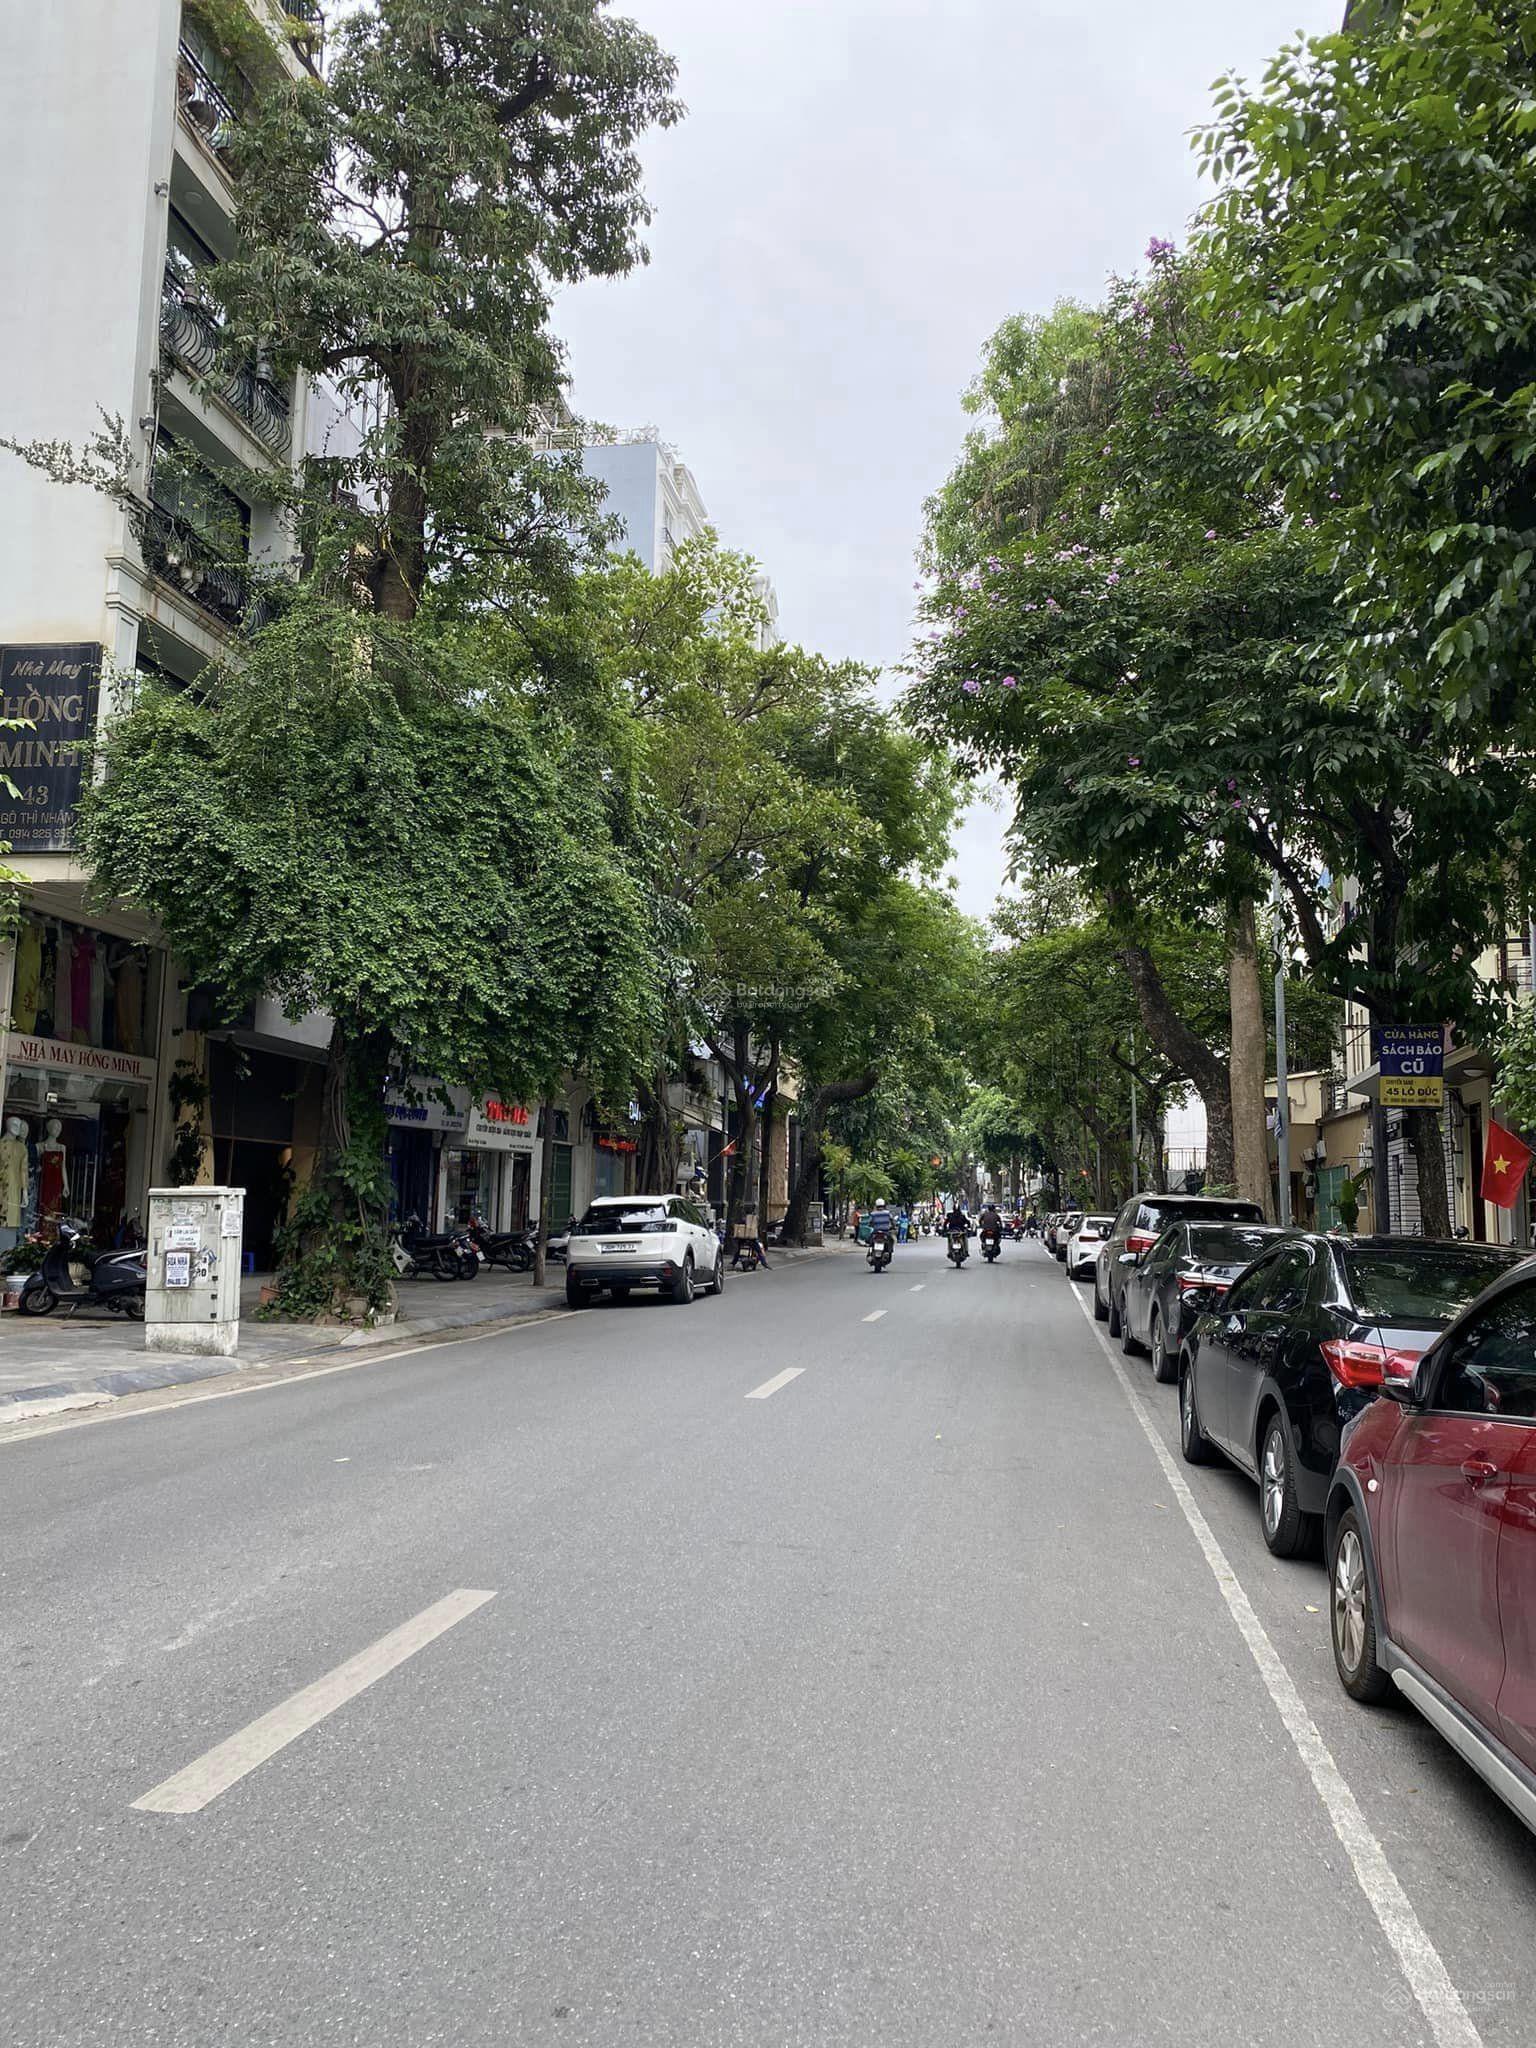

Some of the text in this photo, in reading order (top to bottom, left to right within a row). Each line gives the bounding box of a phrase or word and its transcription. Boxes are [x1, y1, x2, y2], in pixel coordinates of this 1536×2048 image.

[10, 660, 82, 680] Nhà May
[3, 683, 84, 722] HỒNG
[0, 741, 80, 768] MINH
[22, 785, 49, 806] 43
[0, 809, 17, 824] GÔ
[1408, 1028, 1439, 1039] HÀNG
[20, 1039, 46, 1060] NHÀ
[47, 1045, 78, 1065] MAY
[79, 1048, 110, 1070] HỒNG
[110, 1056, 141, 1075] MINH
[1382, 1042, 1442, 1055] SÁCH BÁO
[1400, 1058, 1425, 1074] CŨ
[1386, 1087, 1400, 1096] 45
